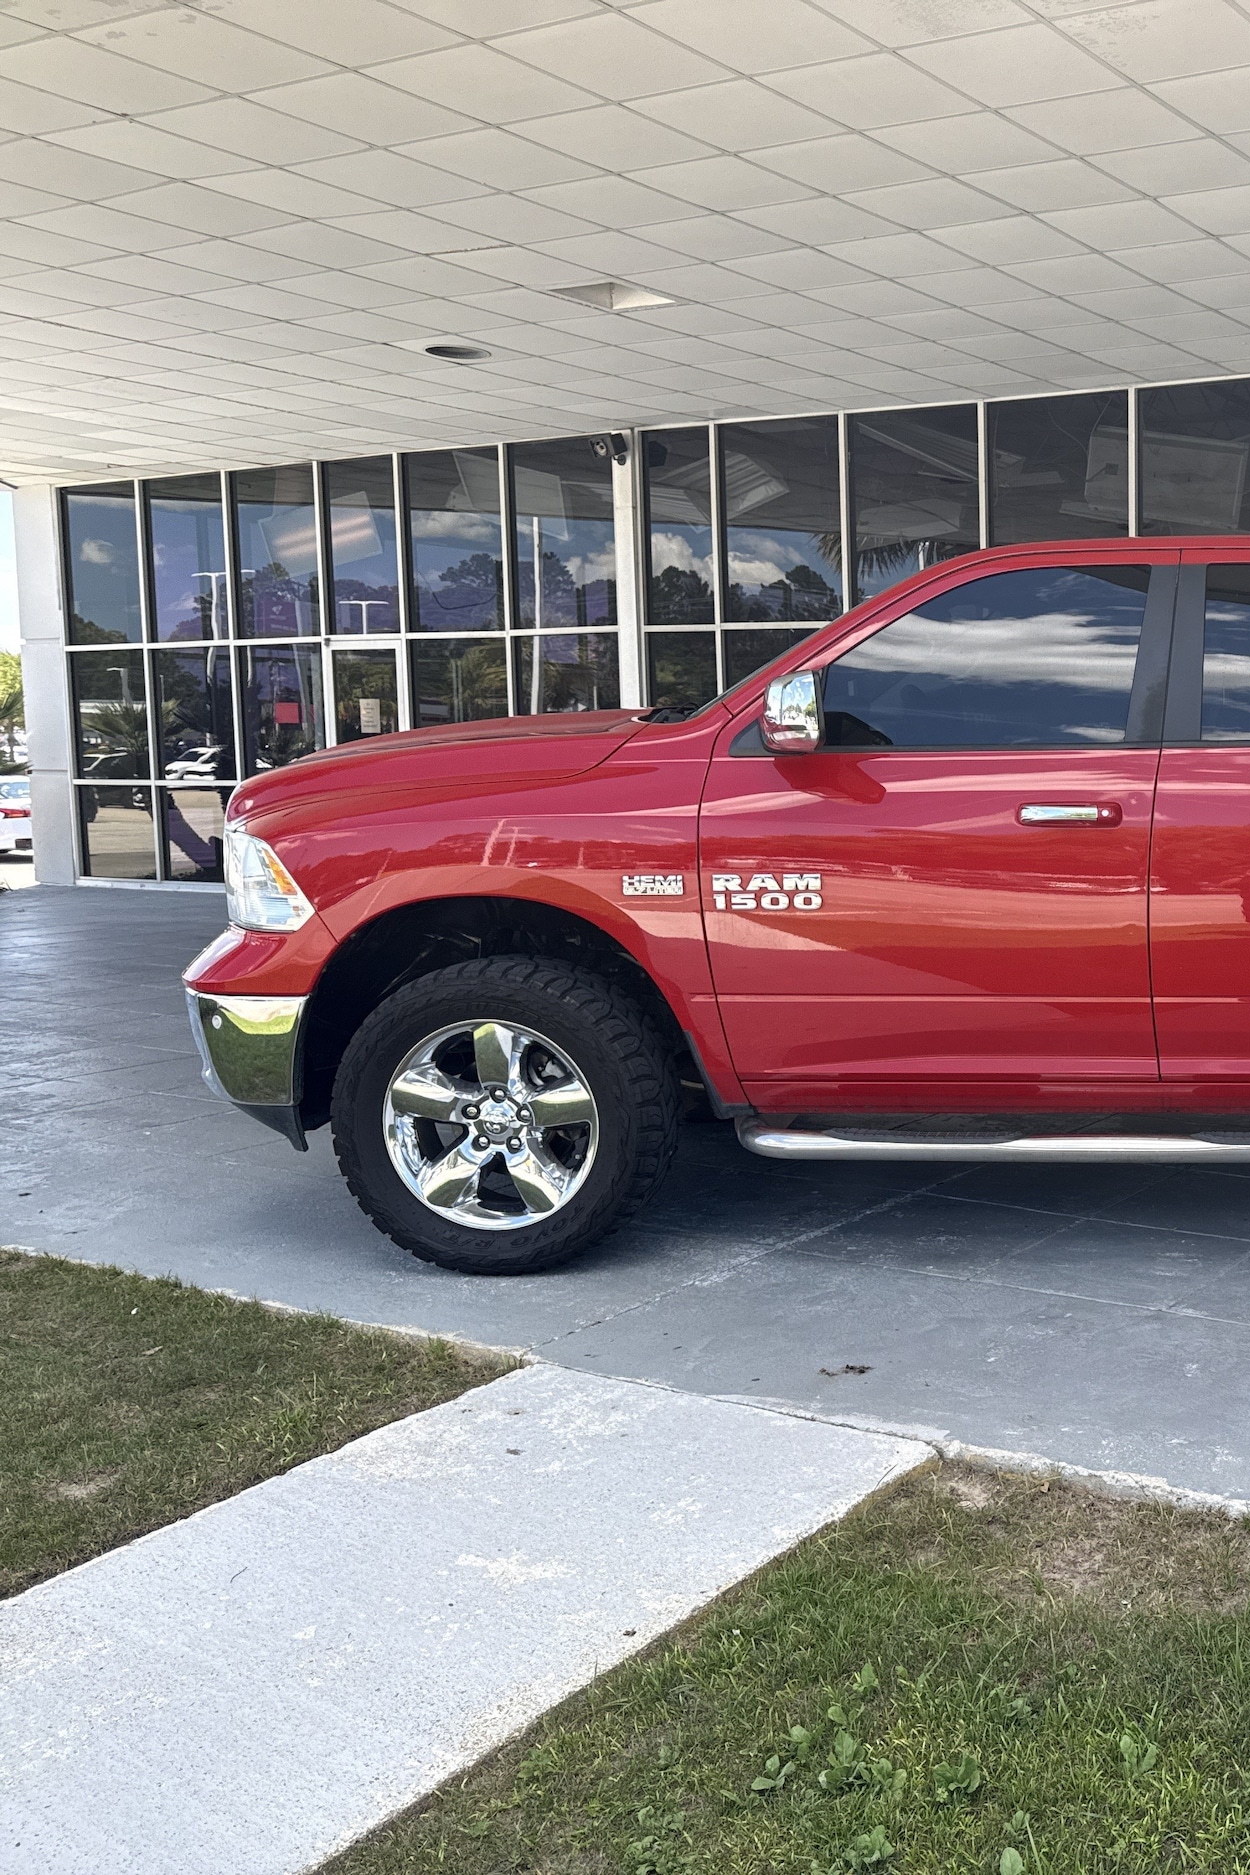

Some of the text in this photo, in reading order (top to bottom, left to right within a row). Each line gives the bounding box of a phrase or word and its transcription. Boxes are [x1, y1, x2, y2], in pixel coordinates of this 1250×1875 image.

[622, 875, 683, 886] HEMI
[712, 873, 822, 891] RAM
[713, 892, 823, 910] 1500
[510, 1206, 585, 1248] TOYO
